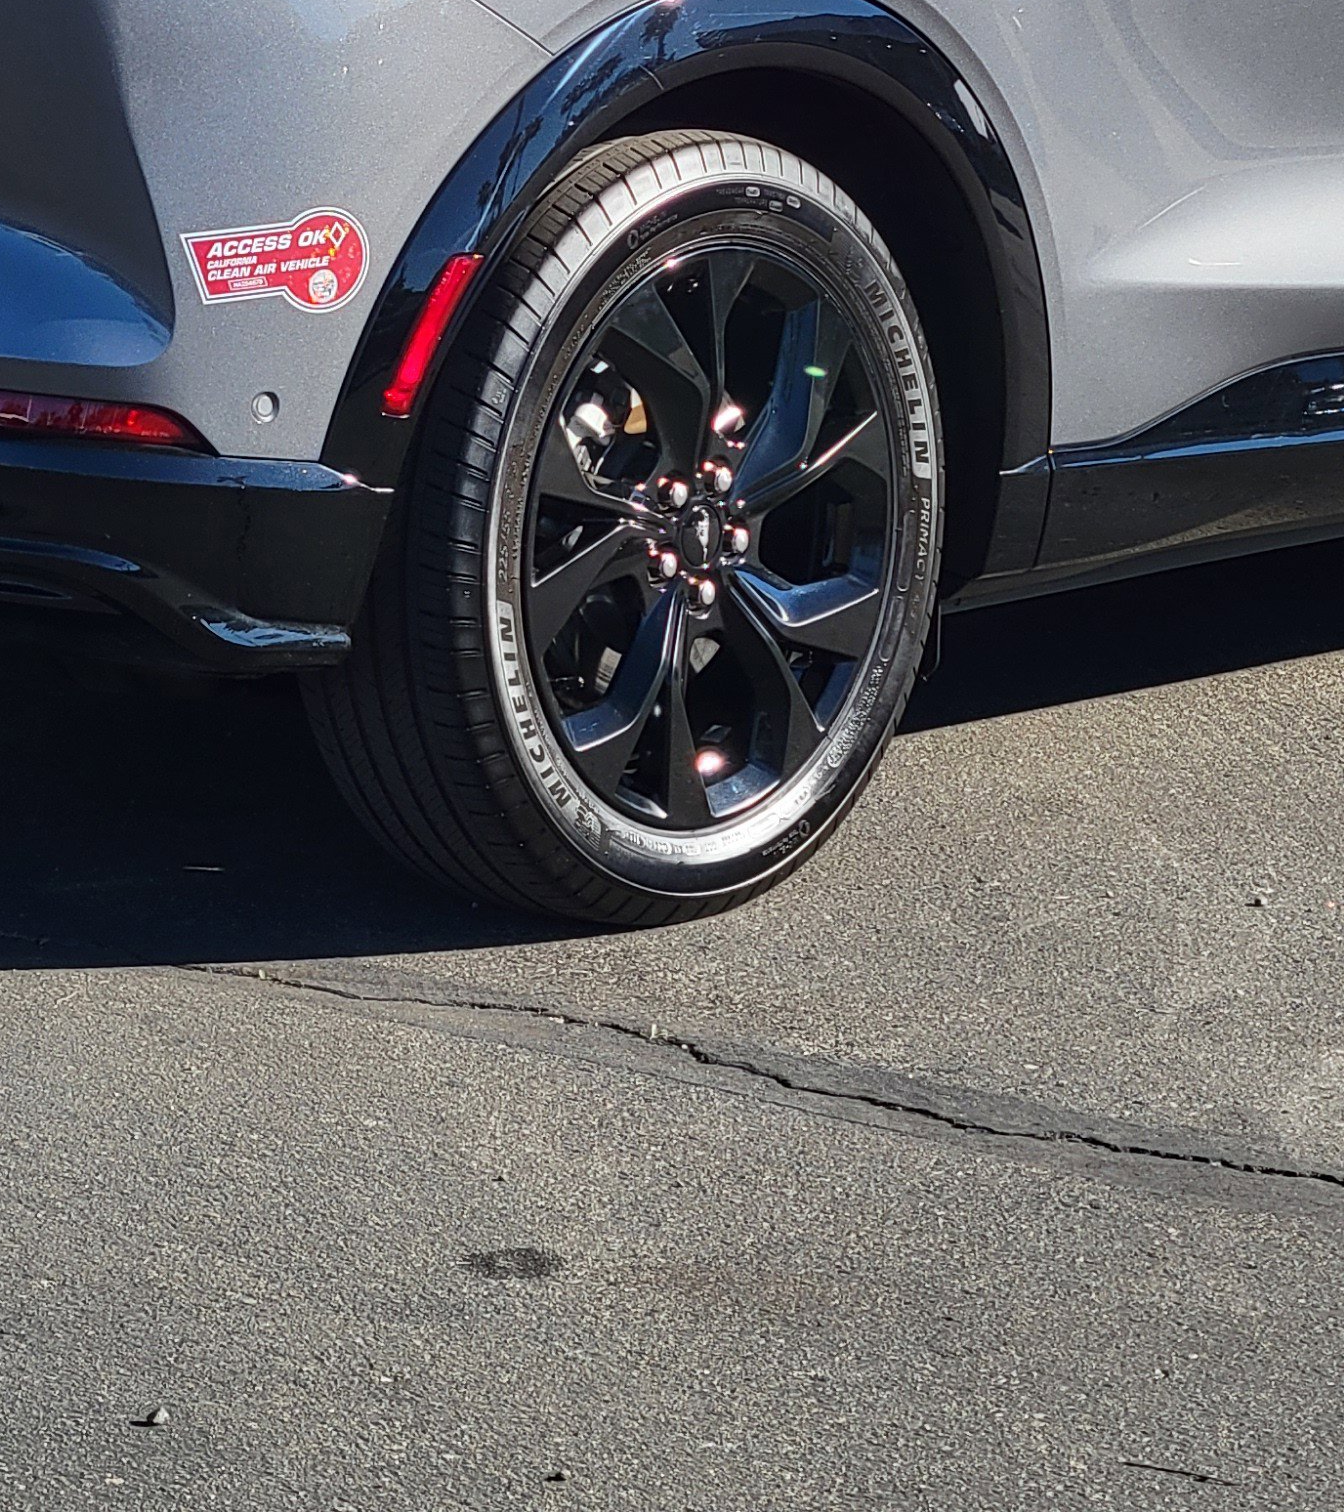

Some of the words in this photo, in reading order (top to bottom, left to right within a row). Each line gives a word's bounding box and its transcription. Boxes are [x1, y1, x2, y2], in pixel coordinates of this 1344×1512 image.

[207, 234, 292, 258] ACCESS
[298, 229, 327, 247] OK
[207, 256, 258, 269] CALIFORNIA
[207, 268, 251, 281] CLEAN
[253, 264, 276, 276] AIR
[280, 256, 331, 273] VEHICLE
[864, 279, 929, 464] MICHELIN
[499, 617, 572, 809] MICHELIN
